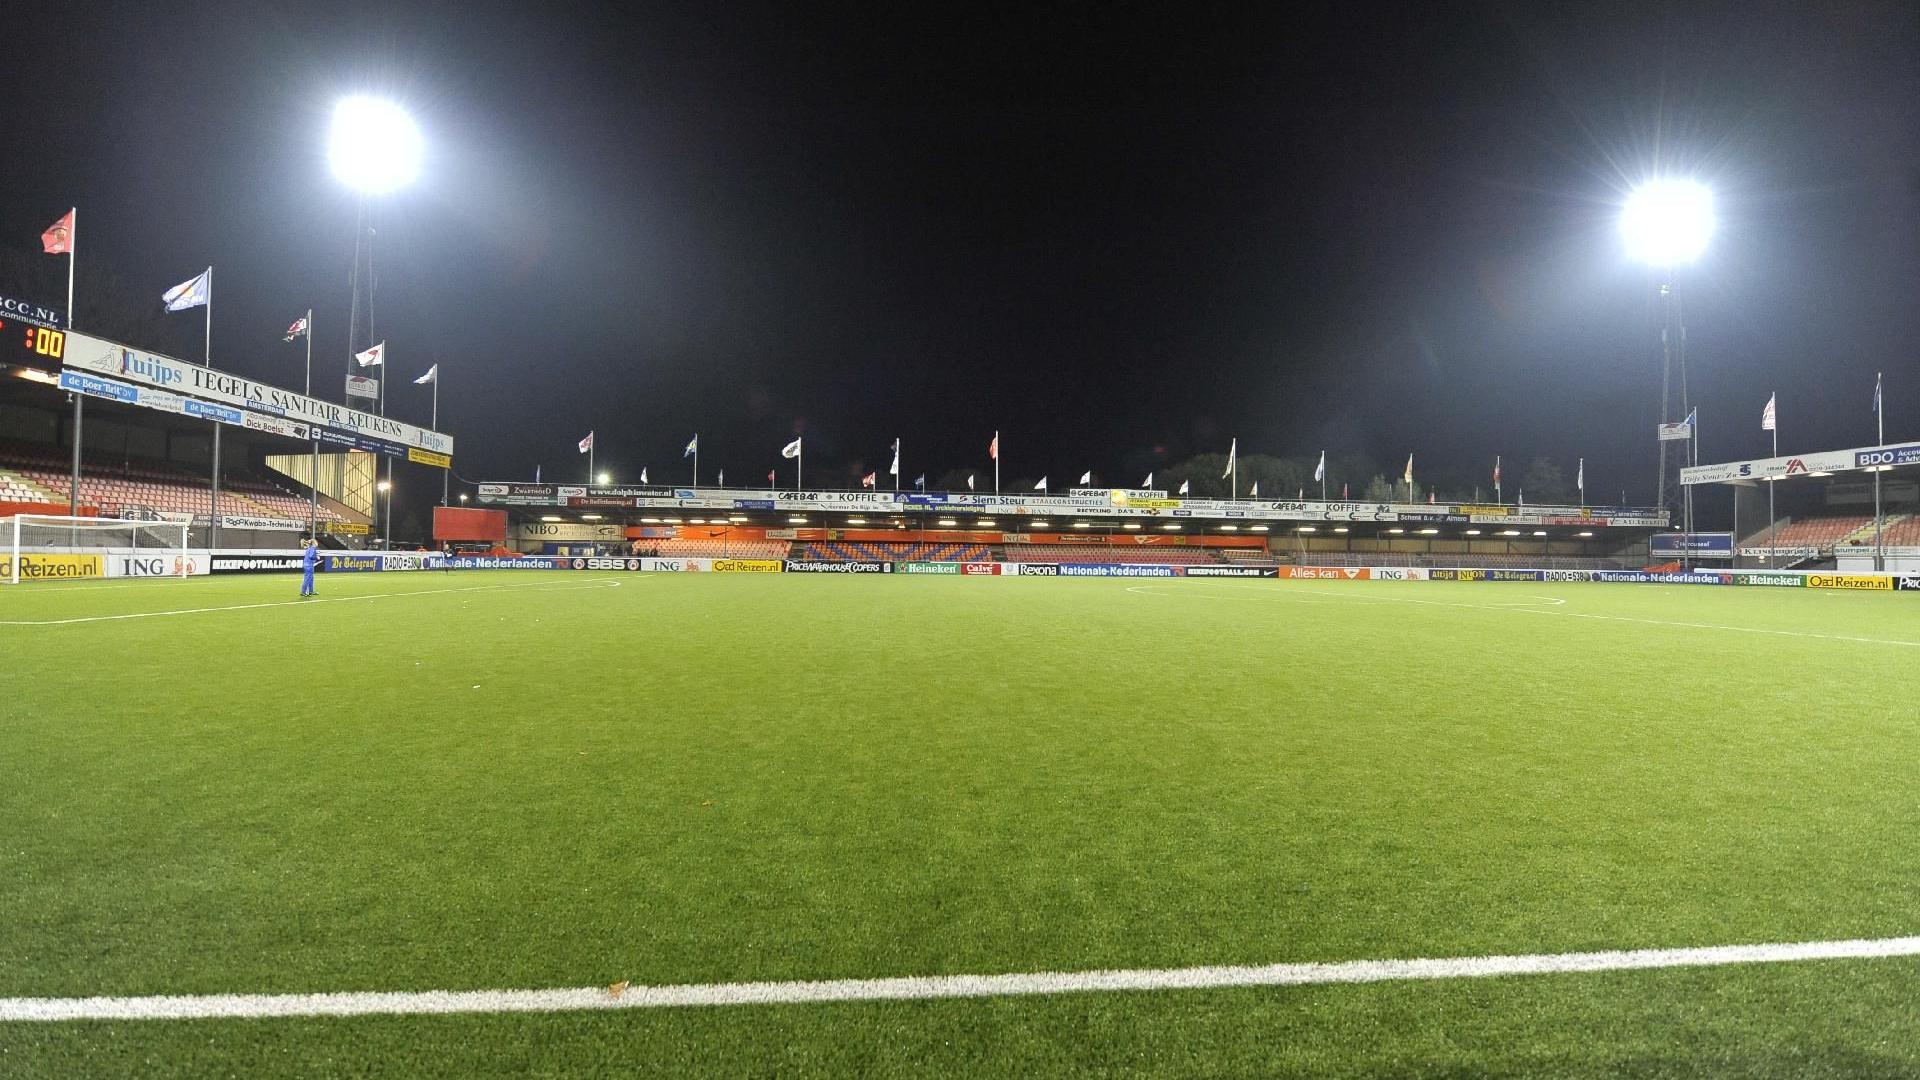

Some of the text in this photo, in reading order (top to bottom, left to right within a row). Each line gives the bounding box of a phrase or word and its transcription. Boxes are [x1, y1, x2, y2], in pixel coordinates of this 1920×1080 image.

[192, 368, 263, 402] TEGELS
[271, 389, 341, 421] SANITAIR
[348, 410, 402, 437] KEUKENS
[246, 418, 262, 428] Dick
[1860, 451, 1894, 466] BDO
[839, 493, 877, 502] KOFFIE
[972, 494, 996, 504] Siem
[1000, 496, 1026, 505] Steur
[1139, 490, 1165, 498] KOFFIE
[997, 507, 1013, 515] ING
[1326, 503, 1360, 512] KOFFIE
[525, 525, 559, 535] NIBO
[19, 556, 97, 578] Reizen.nl
[123, 558, 164, 577] ING
[331, 556, 378, 571] De Telegraaf
[587, 559, 625, 570] SBS
[654, 561, 680, 572] ING
[714, 560, 779, 573] Oad Reizen.nl
[908, 562, 956, 574] Heineken
[1020, 564, 1057, 576] Rexona
[1060, 565, 1171, 577] Nationale-Nederlanden
[1289, 568, 1339, 579] Alles kan
[1380, 570, 1402, 580] ING
[1494, 571, 1503, 579] De
[1600, 572, 1719, 584] Nationale-Nederlanden
[1749, 575, 1801, 586] Heineken
[1810, 575, 1888, 589] Oad Reizen.nl
